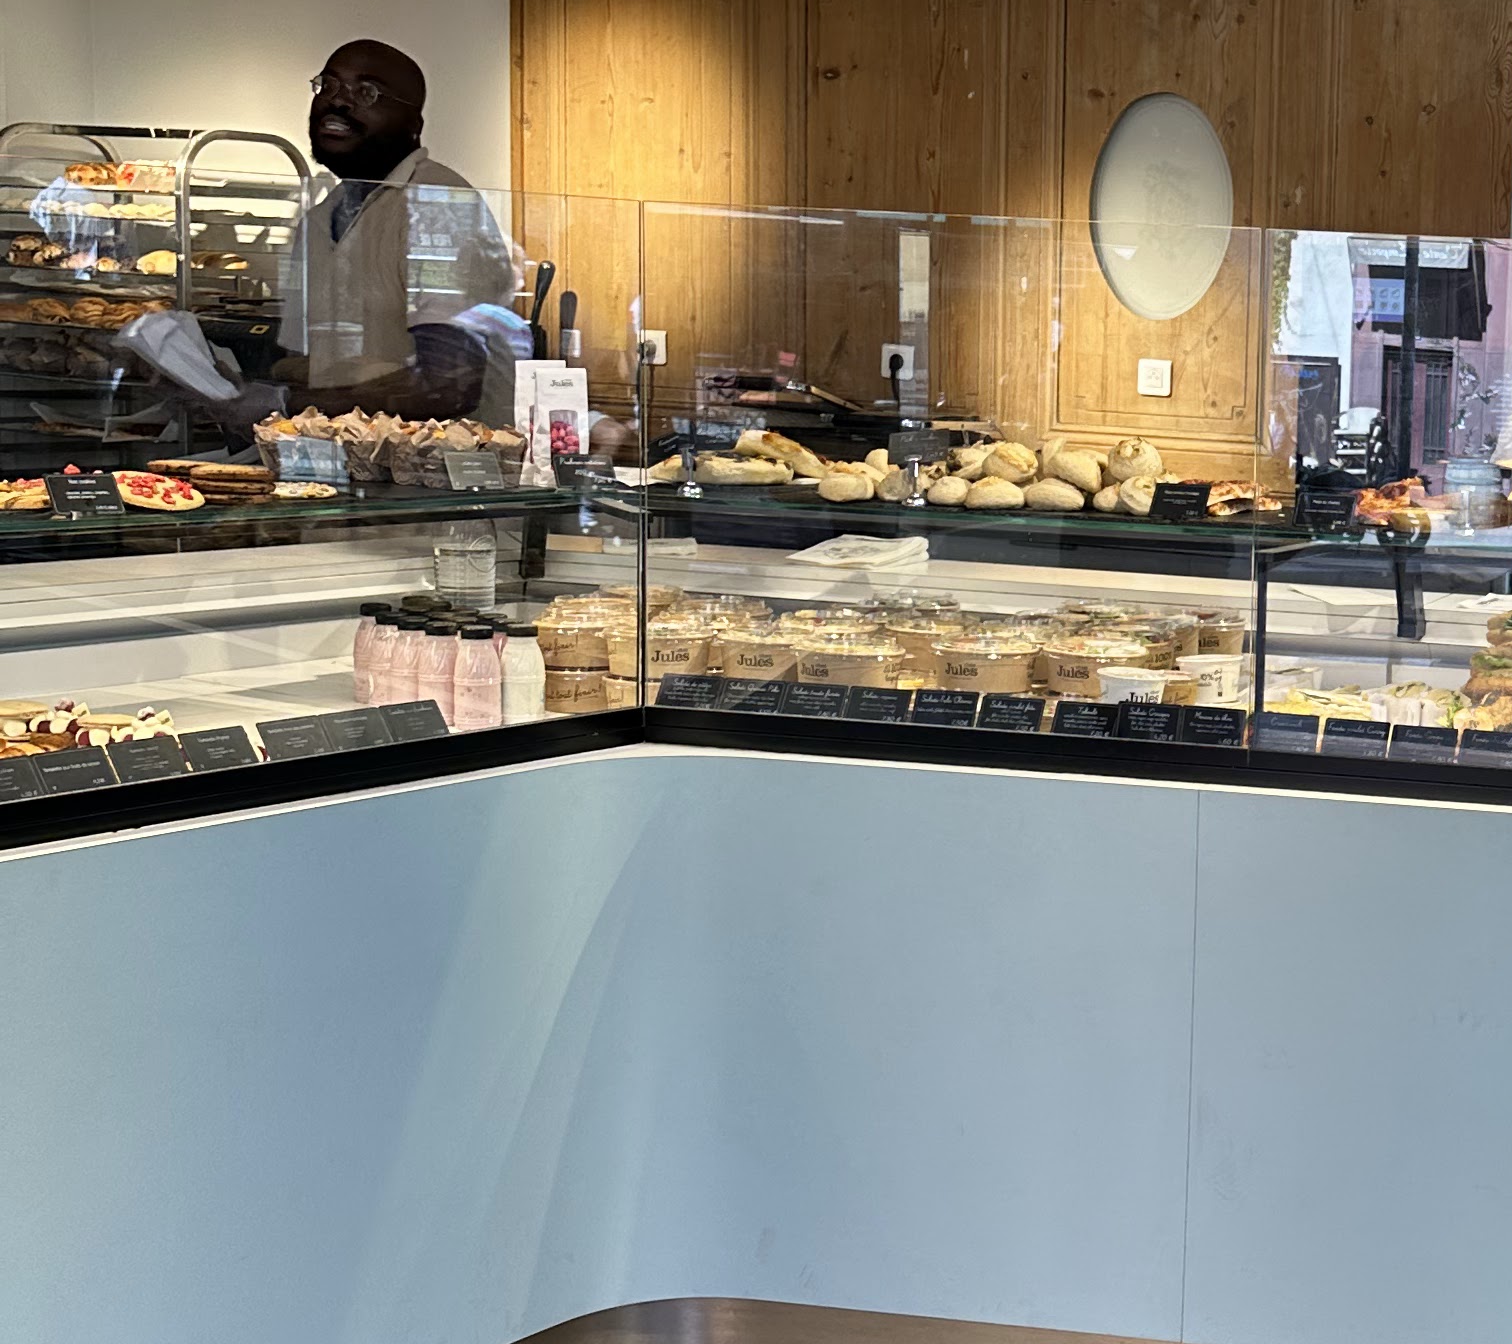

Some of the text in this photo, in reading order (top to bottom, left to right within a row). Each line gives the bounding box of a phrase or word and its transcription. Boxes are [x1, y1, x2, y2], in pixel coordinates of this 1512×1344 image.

[650, 649, 690, 663] Jules
[737, 654, 774, 668] Jules
[800, 663, 829, 677] Jules
[945, 662, 978, 677] Jules
[1056, 665, 1090, 679] Jules
[1125, 692, 1160, 705] Jules
